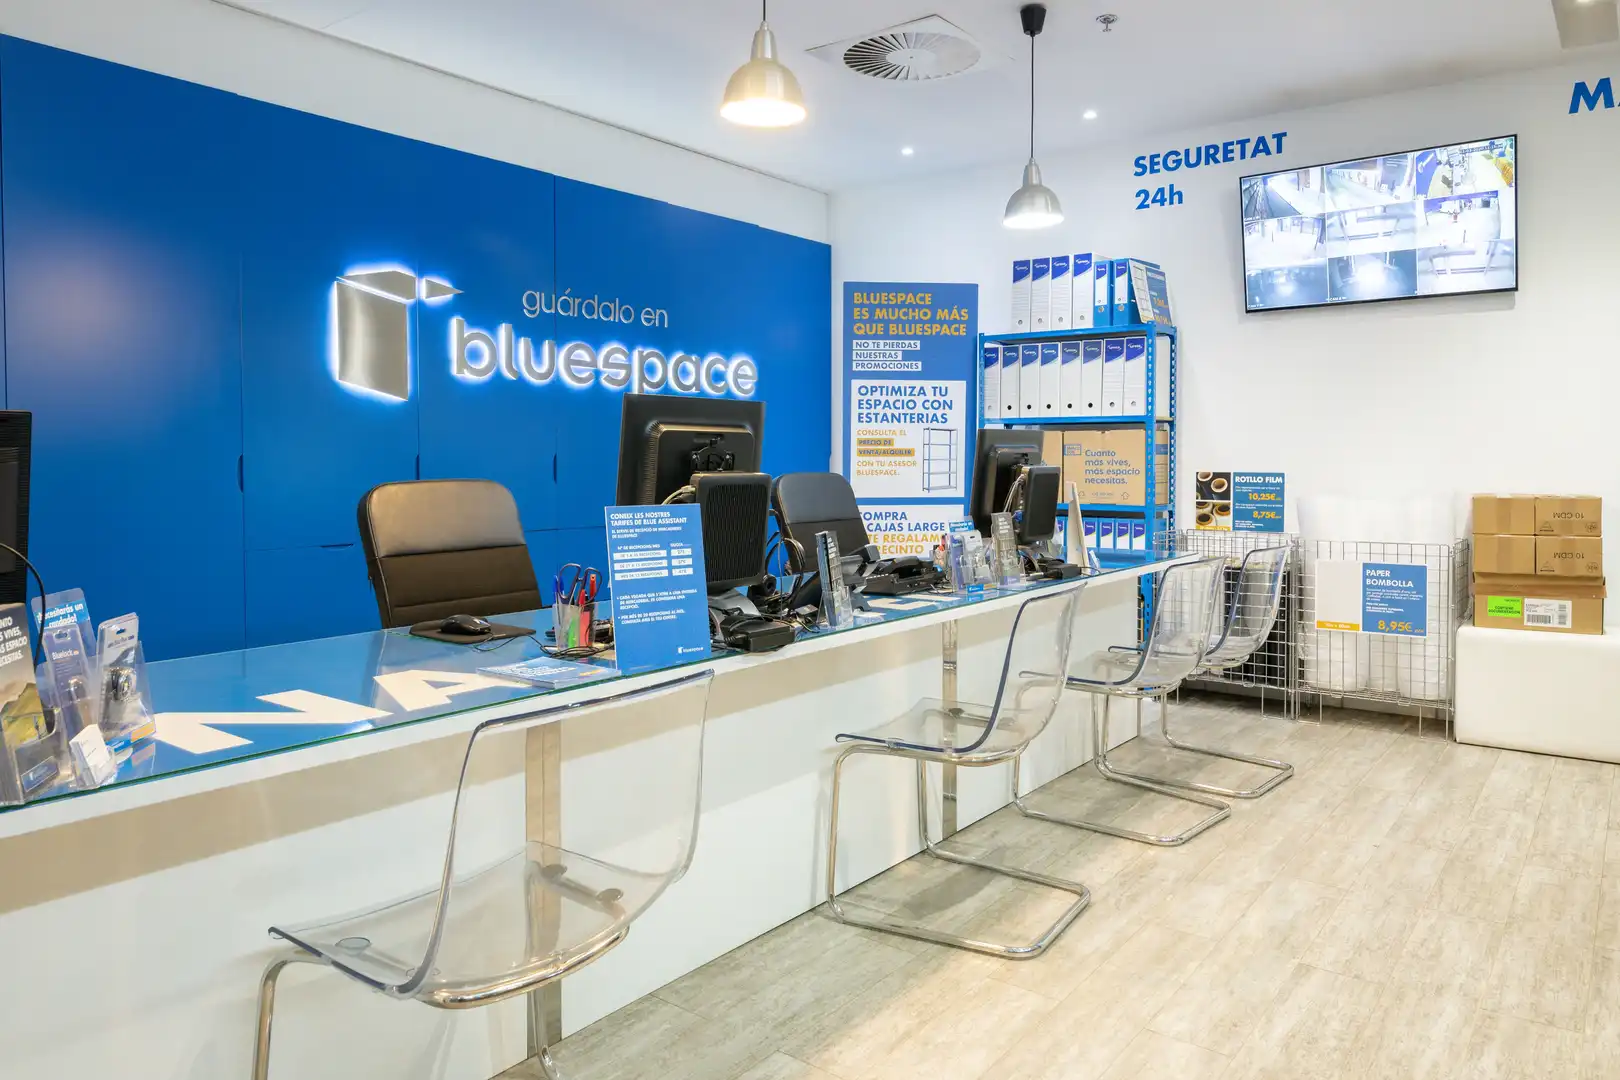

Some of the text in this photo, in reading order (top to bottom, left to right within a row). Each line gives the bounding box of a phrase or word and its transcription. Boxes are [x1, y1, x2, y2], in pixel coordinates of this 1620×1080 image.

[1568, 76, 1620, 114] M
[1133, 132, 1287, 177] SEGURETAT
[1135, 184, 1184, 210] 24h
[853, 292, 932, 304] BLUESPACE
[522, 288, 668, 328] guárdalo en
[853, 305, 969, 320] ES MUCHO MÁS
[853, 323, 967, 336] QUE BLUESPACE
[454, 317, 758, 395] bluespace
[858, 385, 948, 397] OPTIMIZA TU
[858, 399, 953, 410] ESPACIO CON
[858, 412, 948, 423] ESTANTERIAS
[1107, 458, 1130, 467] vives,
[1107, 468, 1140, 476] espacio
[1248, 493, 1276, 501] 10,25€
[860, 512, 908, 521] OMPRA
[1253, 511, 1276, 519] 8,75€
[867, 522, 904, 532] CAJAS
[908, 522, 945, 532] LARGE
[868, 534, 942, 543] TE REGALAM
[1366, 579, 1414, 587] BOMBOLLA
[1378, 620, 1413, 632] 8,95€
